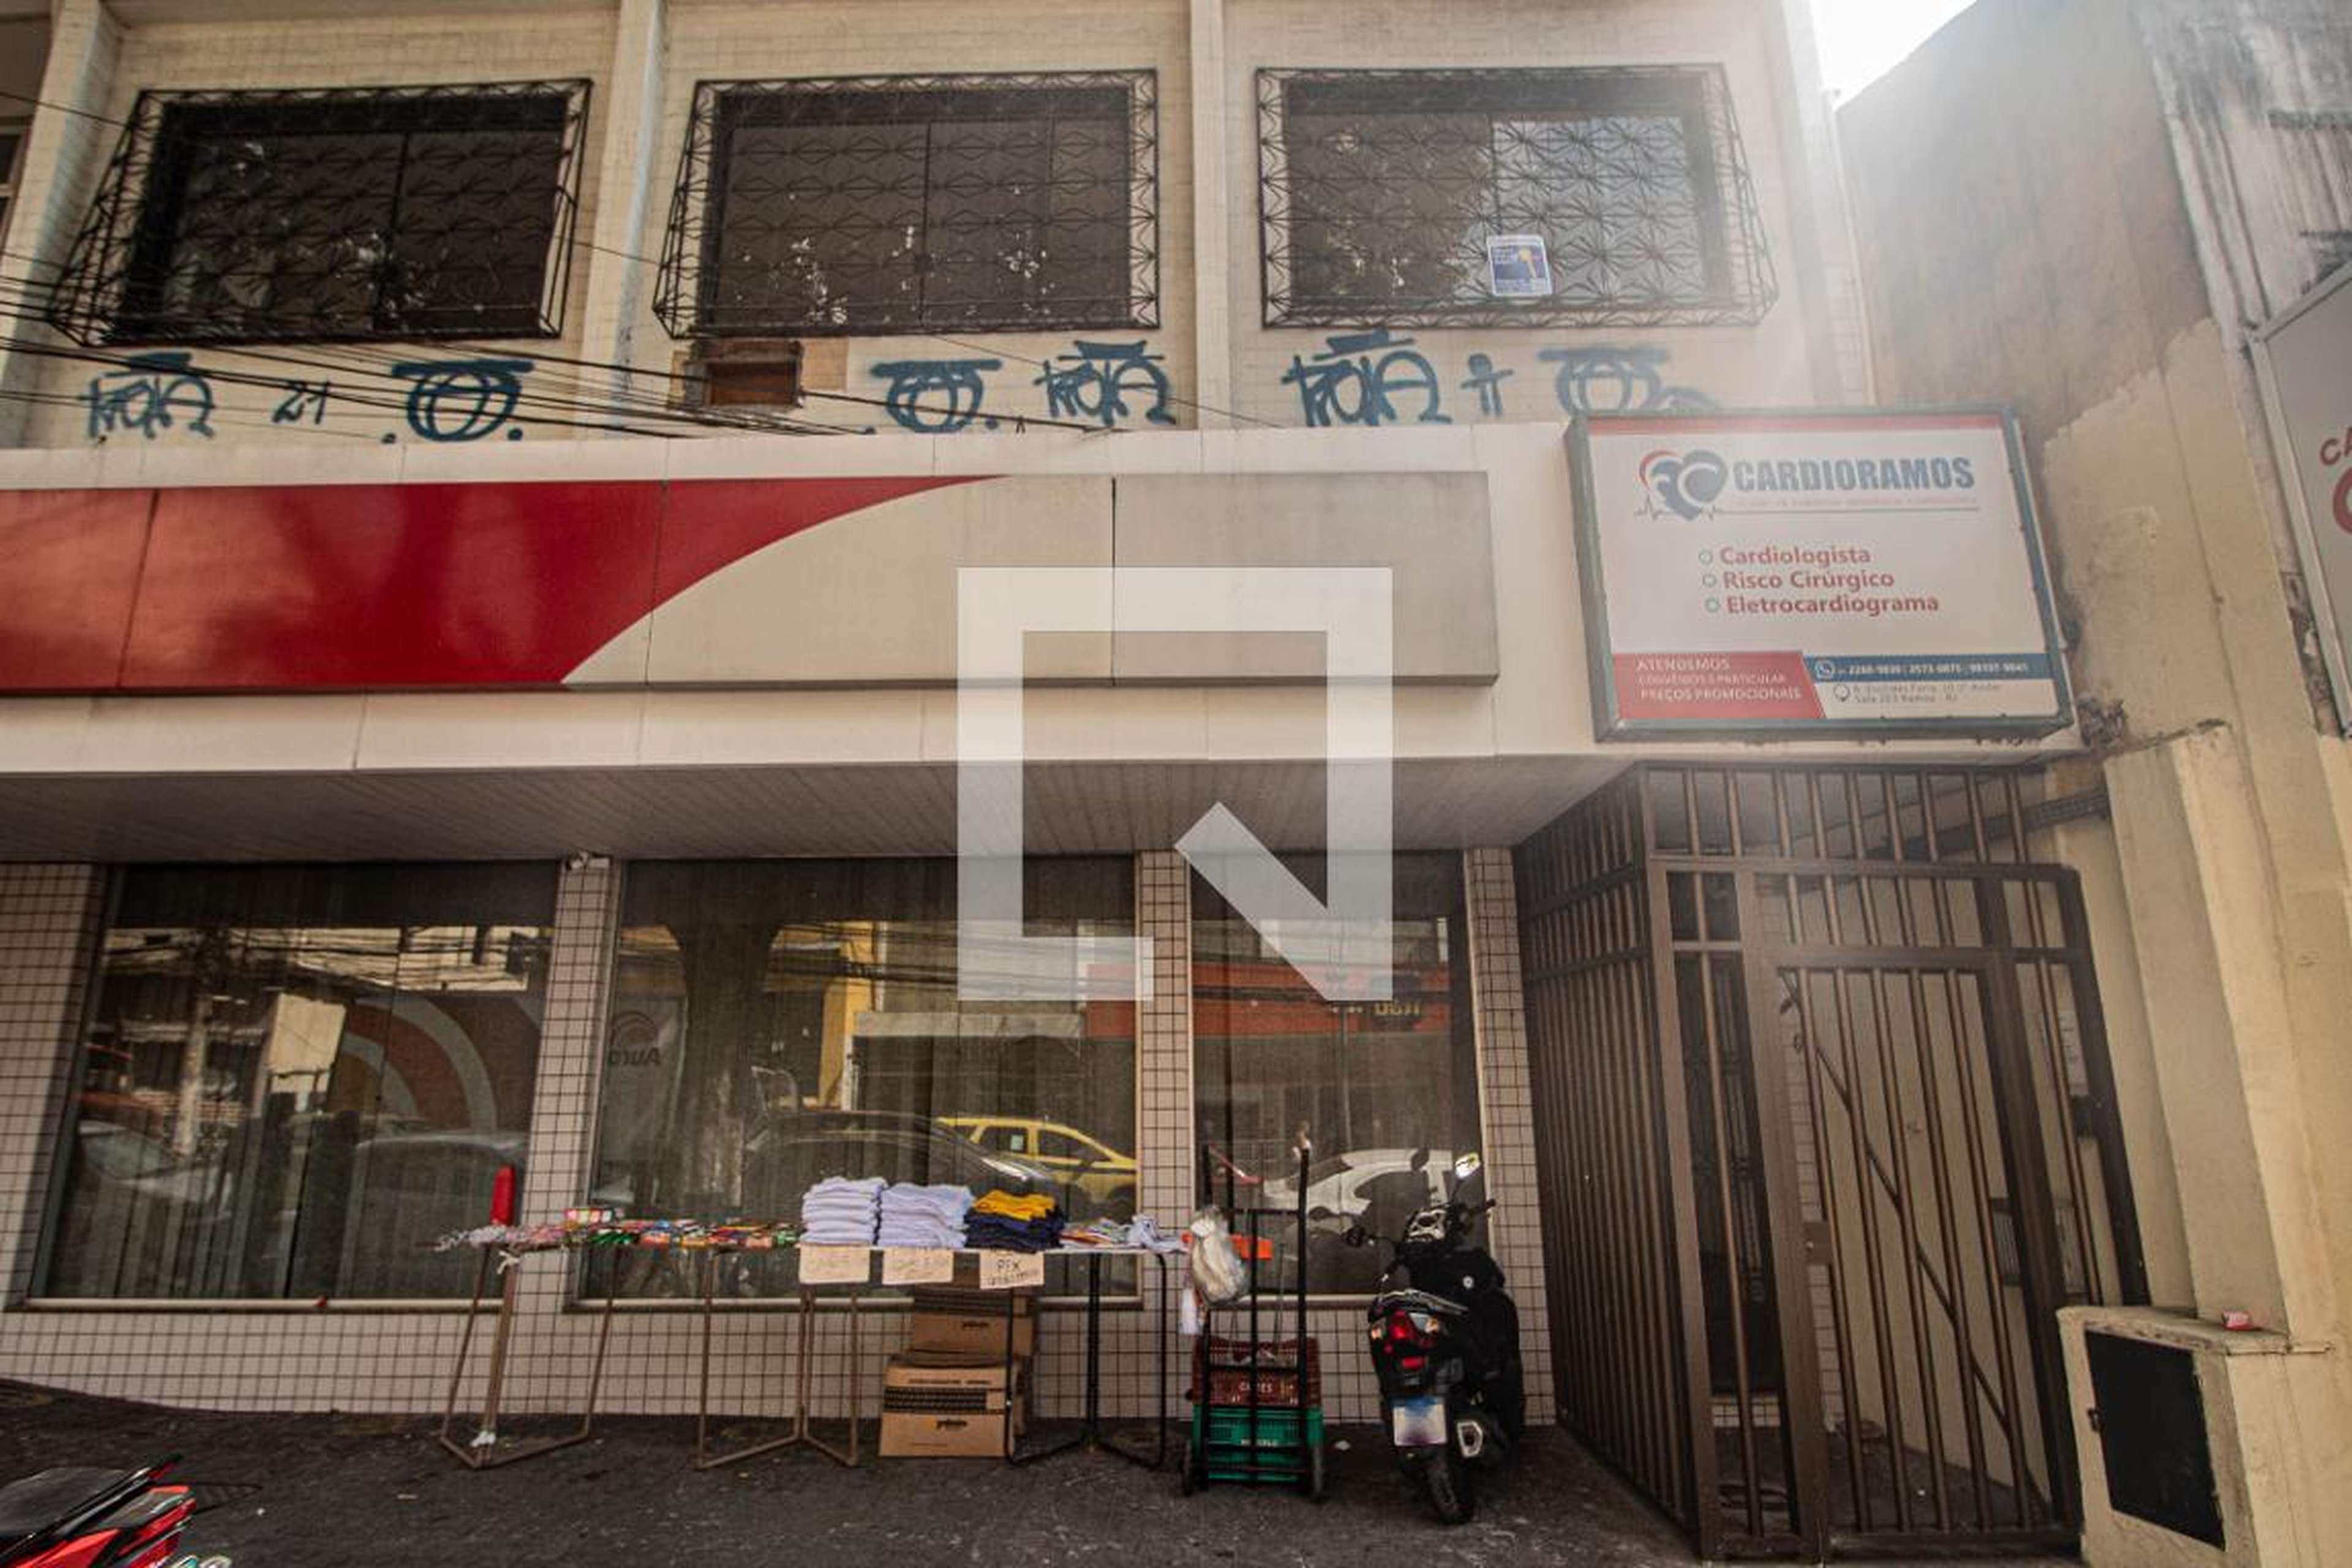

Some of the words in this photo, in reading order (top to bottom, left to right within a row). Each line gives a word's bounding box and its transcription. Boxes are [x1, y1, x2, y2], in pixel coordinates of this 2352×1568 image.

[1733, 457, 1975, 492] CARDIORAMOS
[1719, 546, 1871, 568] Cardiologista
[1723, 571, 1783, 589] Risco
[1790, 570, 1895, 593] Cirúrgico
[1727, 594, 1939, 617] Eletrocardiograma
[1636, 657, 1730, 671] ATENDEMOS
